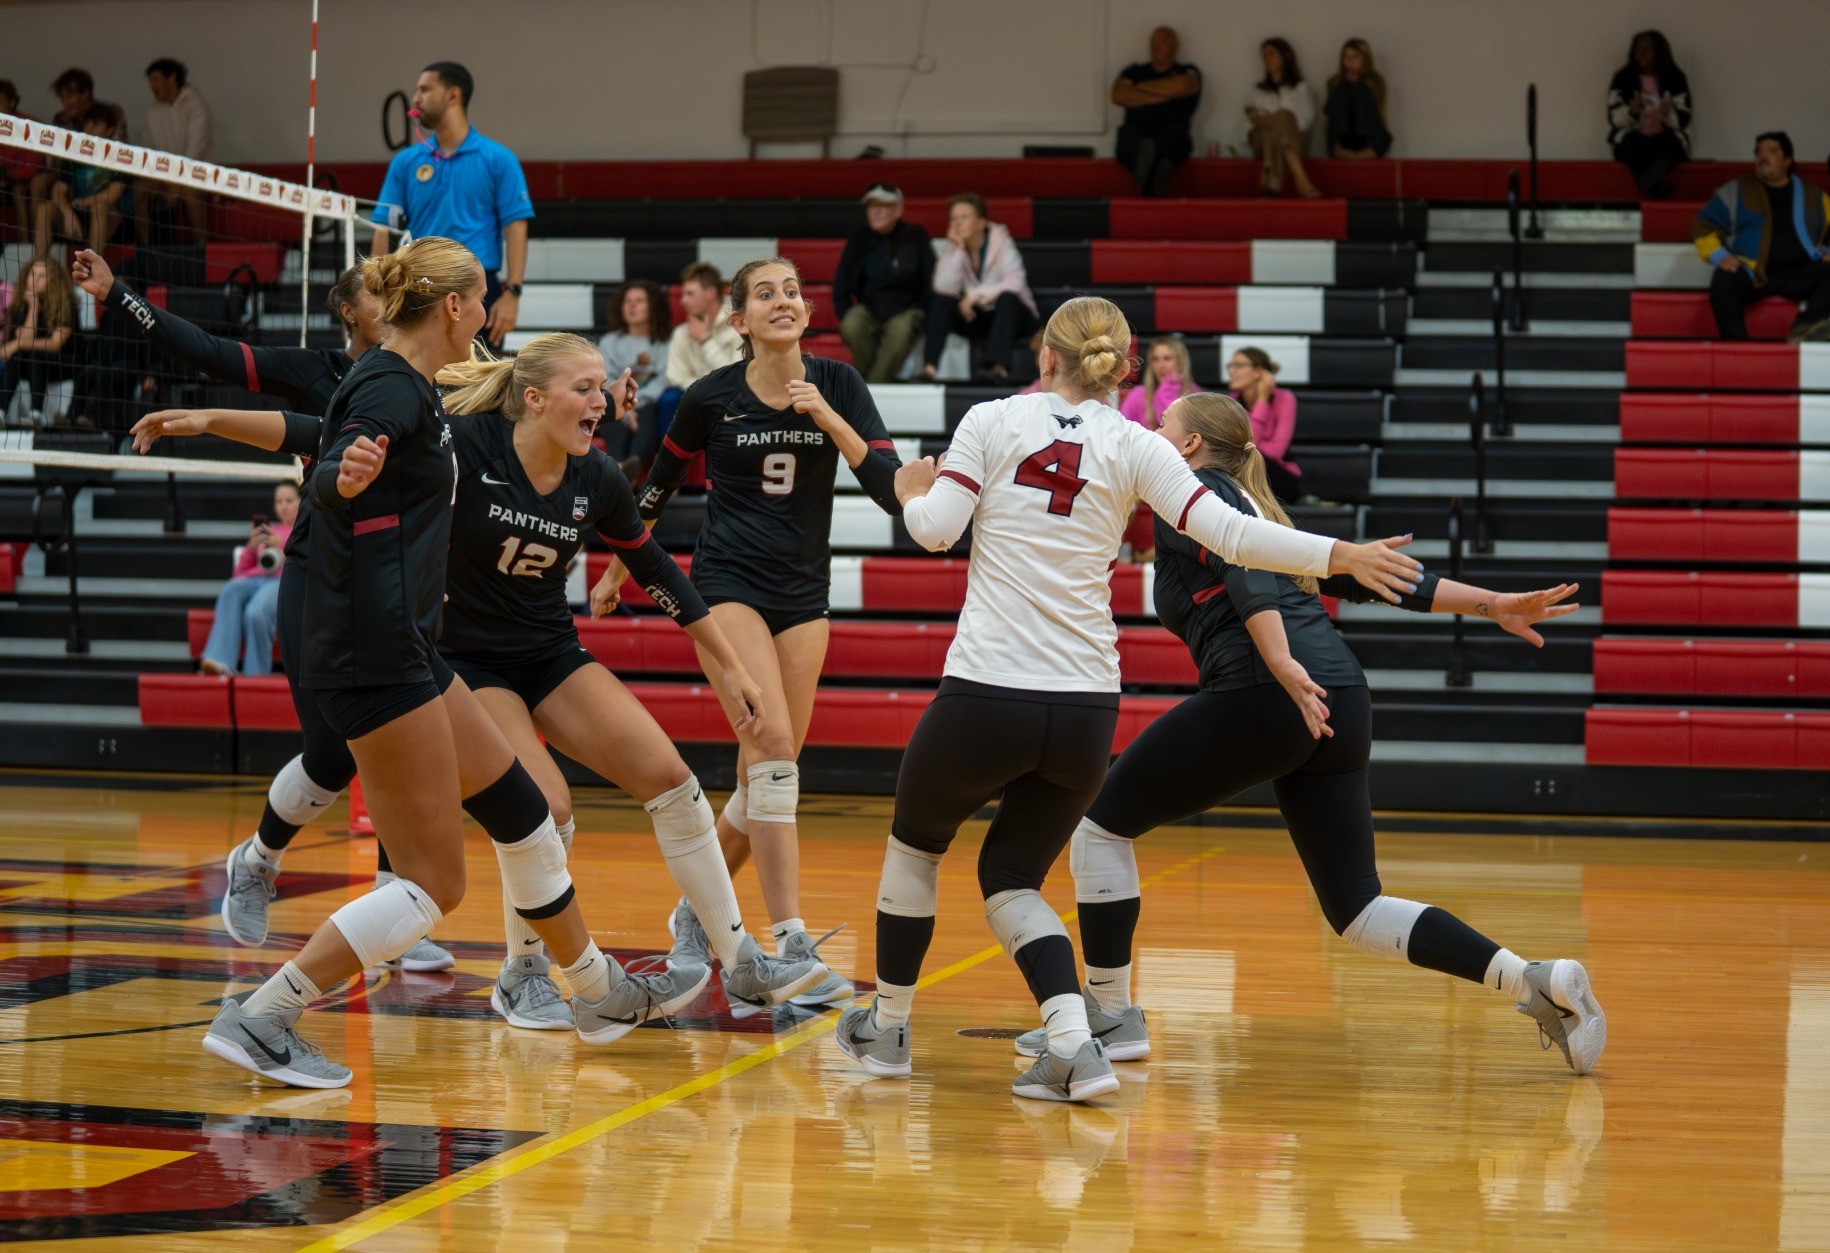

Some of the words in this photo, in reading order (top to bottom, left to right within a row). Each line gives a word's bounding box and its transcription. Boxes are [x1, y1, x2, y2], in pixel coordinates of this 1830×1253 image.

[121, 292, 155, 330] TECH
[737, 430, 824, 447] PANTHERS
[762, 452, 797, 494] 9
[1013, 438, 1089, 517] 4
[639, 486, 664, 509] TEC
[488, 503, 579, 542] PANTHERS
[497, 536, 559, 579] 12
